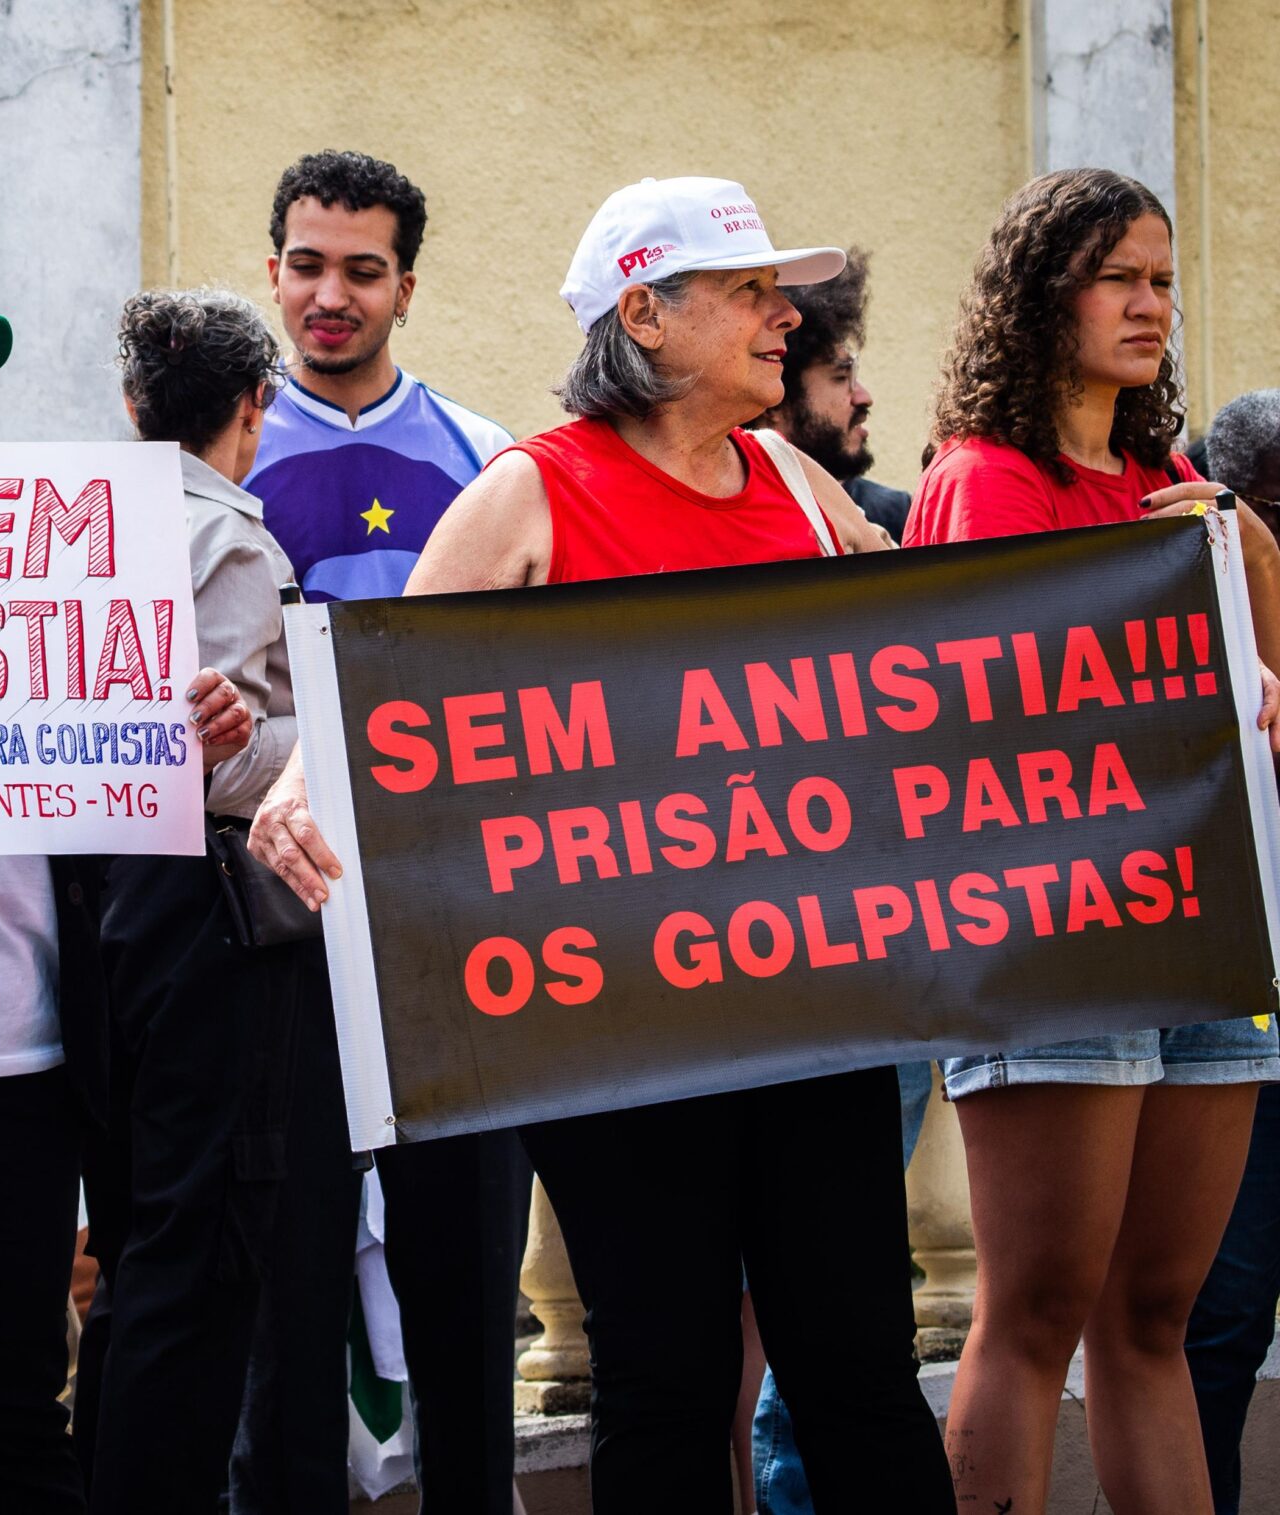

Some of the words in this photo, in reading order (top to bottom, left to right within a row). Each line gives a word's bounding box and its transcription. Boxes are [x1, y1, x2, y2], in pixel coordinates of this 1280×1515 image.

[711, 208, 721, 219] O
[617, 246, 648, 278] PT
[366, 680, 616, 794] SEM
[675, 613, 1218, 758] ANISTIA!!!
[36, 722, 188, 767] GOLPISTAS
[102, 783, 159, 818] MG
[480, 770, 852, 894] PRISÃO
[892, 743, 1146, 839] PARA
[464, 926, 604, 1016] OS
[653, 846, 1201, 989] GOLPISTAS!
